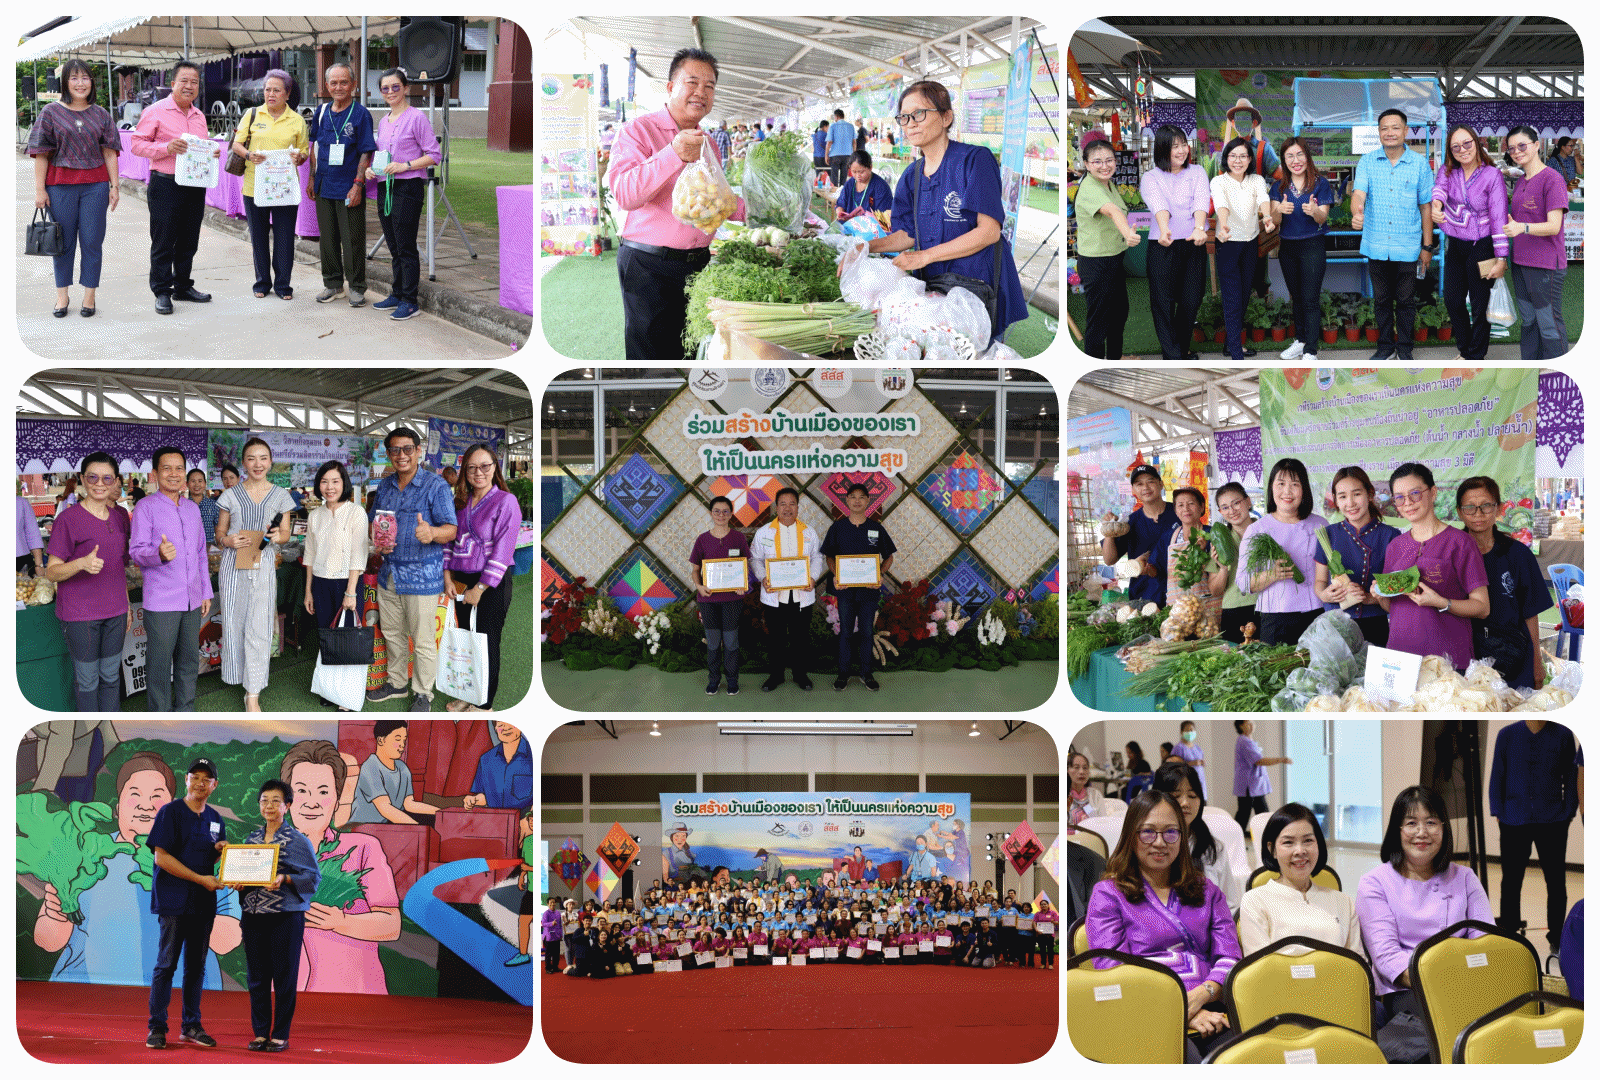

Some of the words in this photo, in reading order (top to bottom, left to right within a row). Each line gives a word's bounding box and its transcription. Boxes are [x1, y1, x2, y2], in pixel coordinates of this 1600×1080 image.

[687, 412, 917, 437] ร่วมสร้างบ้านเมืองของเรา
[1452, 419, 1485, 440] กลางน้ำ
[704, 446, 903, 475] ให้เป็นนครแห่งความสุข
[673, 799, 823, 816] ร่วมสร้างบ้านเมืองของเรา
[825, 798, 954, 820] ให้เป็นนครแห่งความสุข
